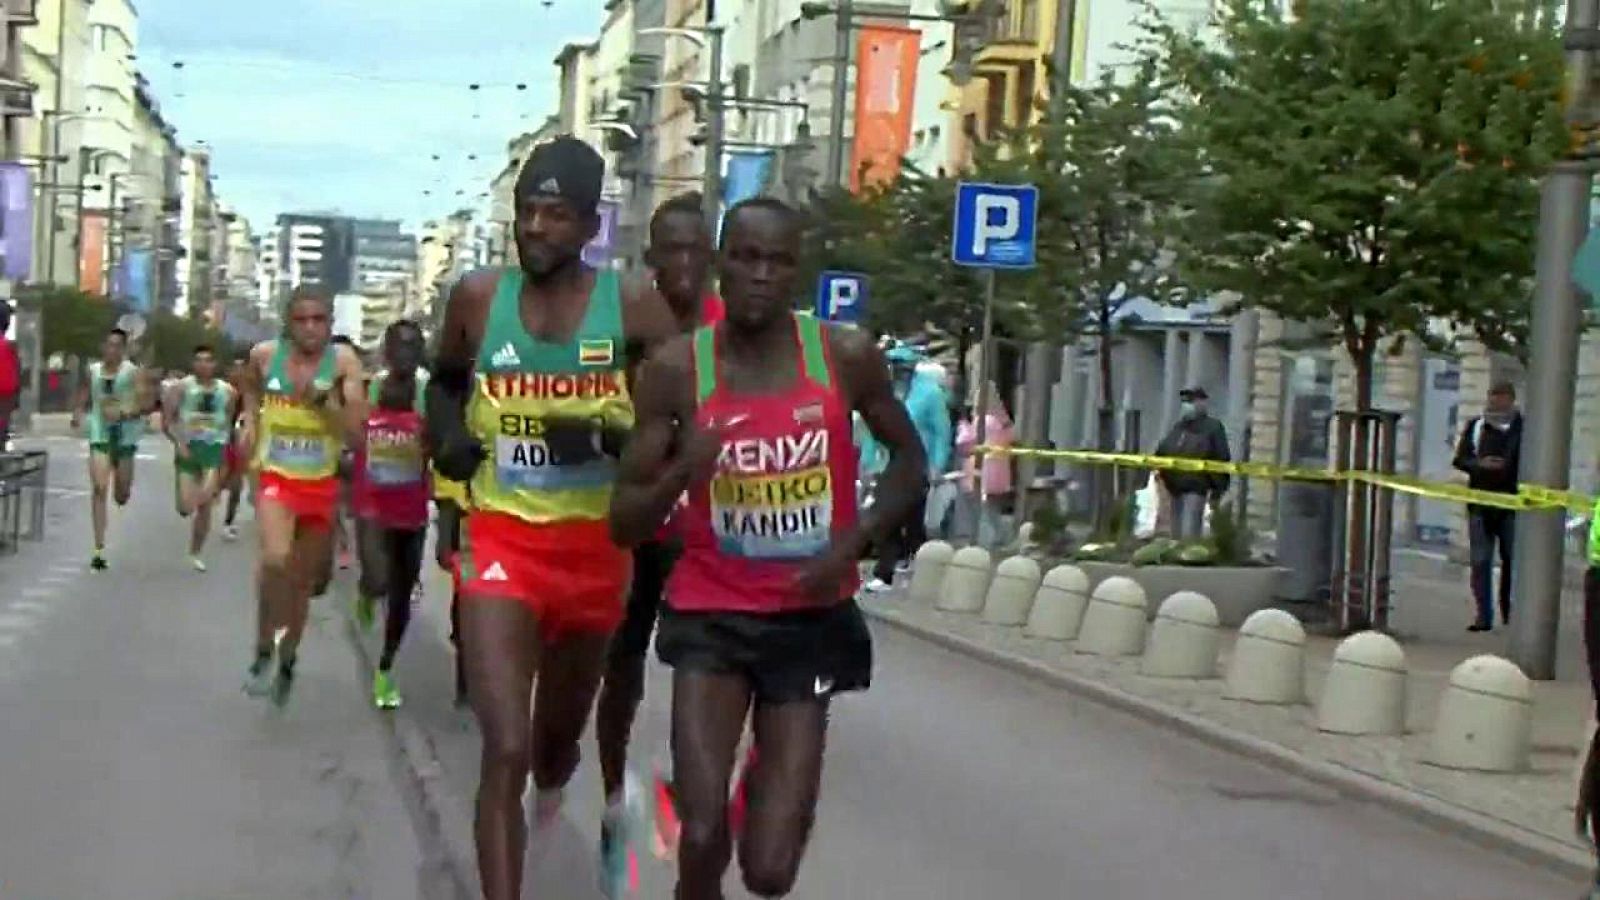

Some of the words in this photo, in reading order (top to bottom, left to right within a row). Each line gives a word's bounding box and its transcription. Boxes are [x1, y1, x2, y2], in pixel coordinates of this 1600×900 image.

[973, 194, 1019, 256] P
[829, 278, 859, 315] P
[486, 373, 622, 400] ETHIOPIA
